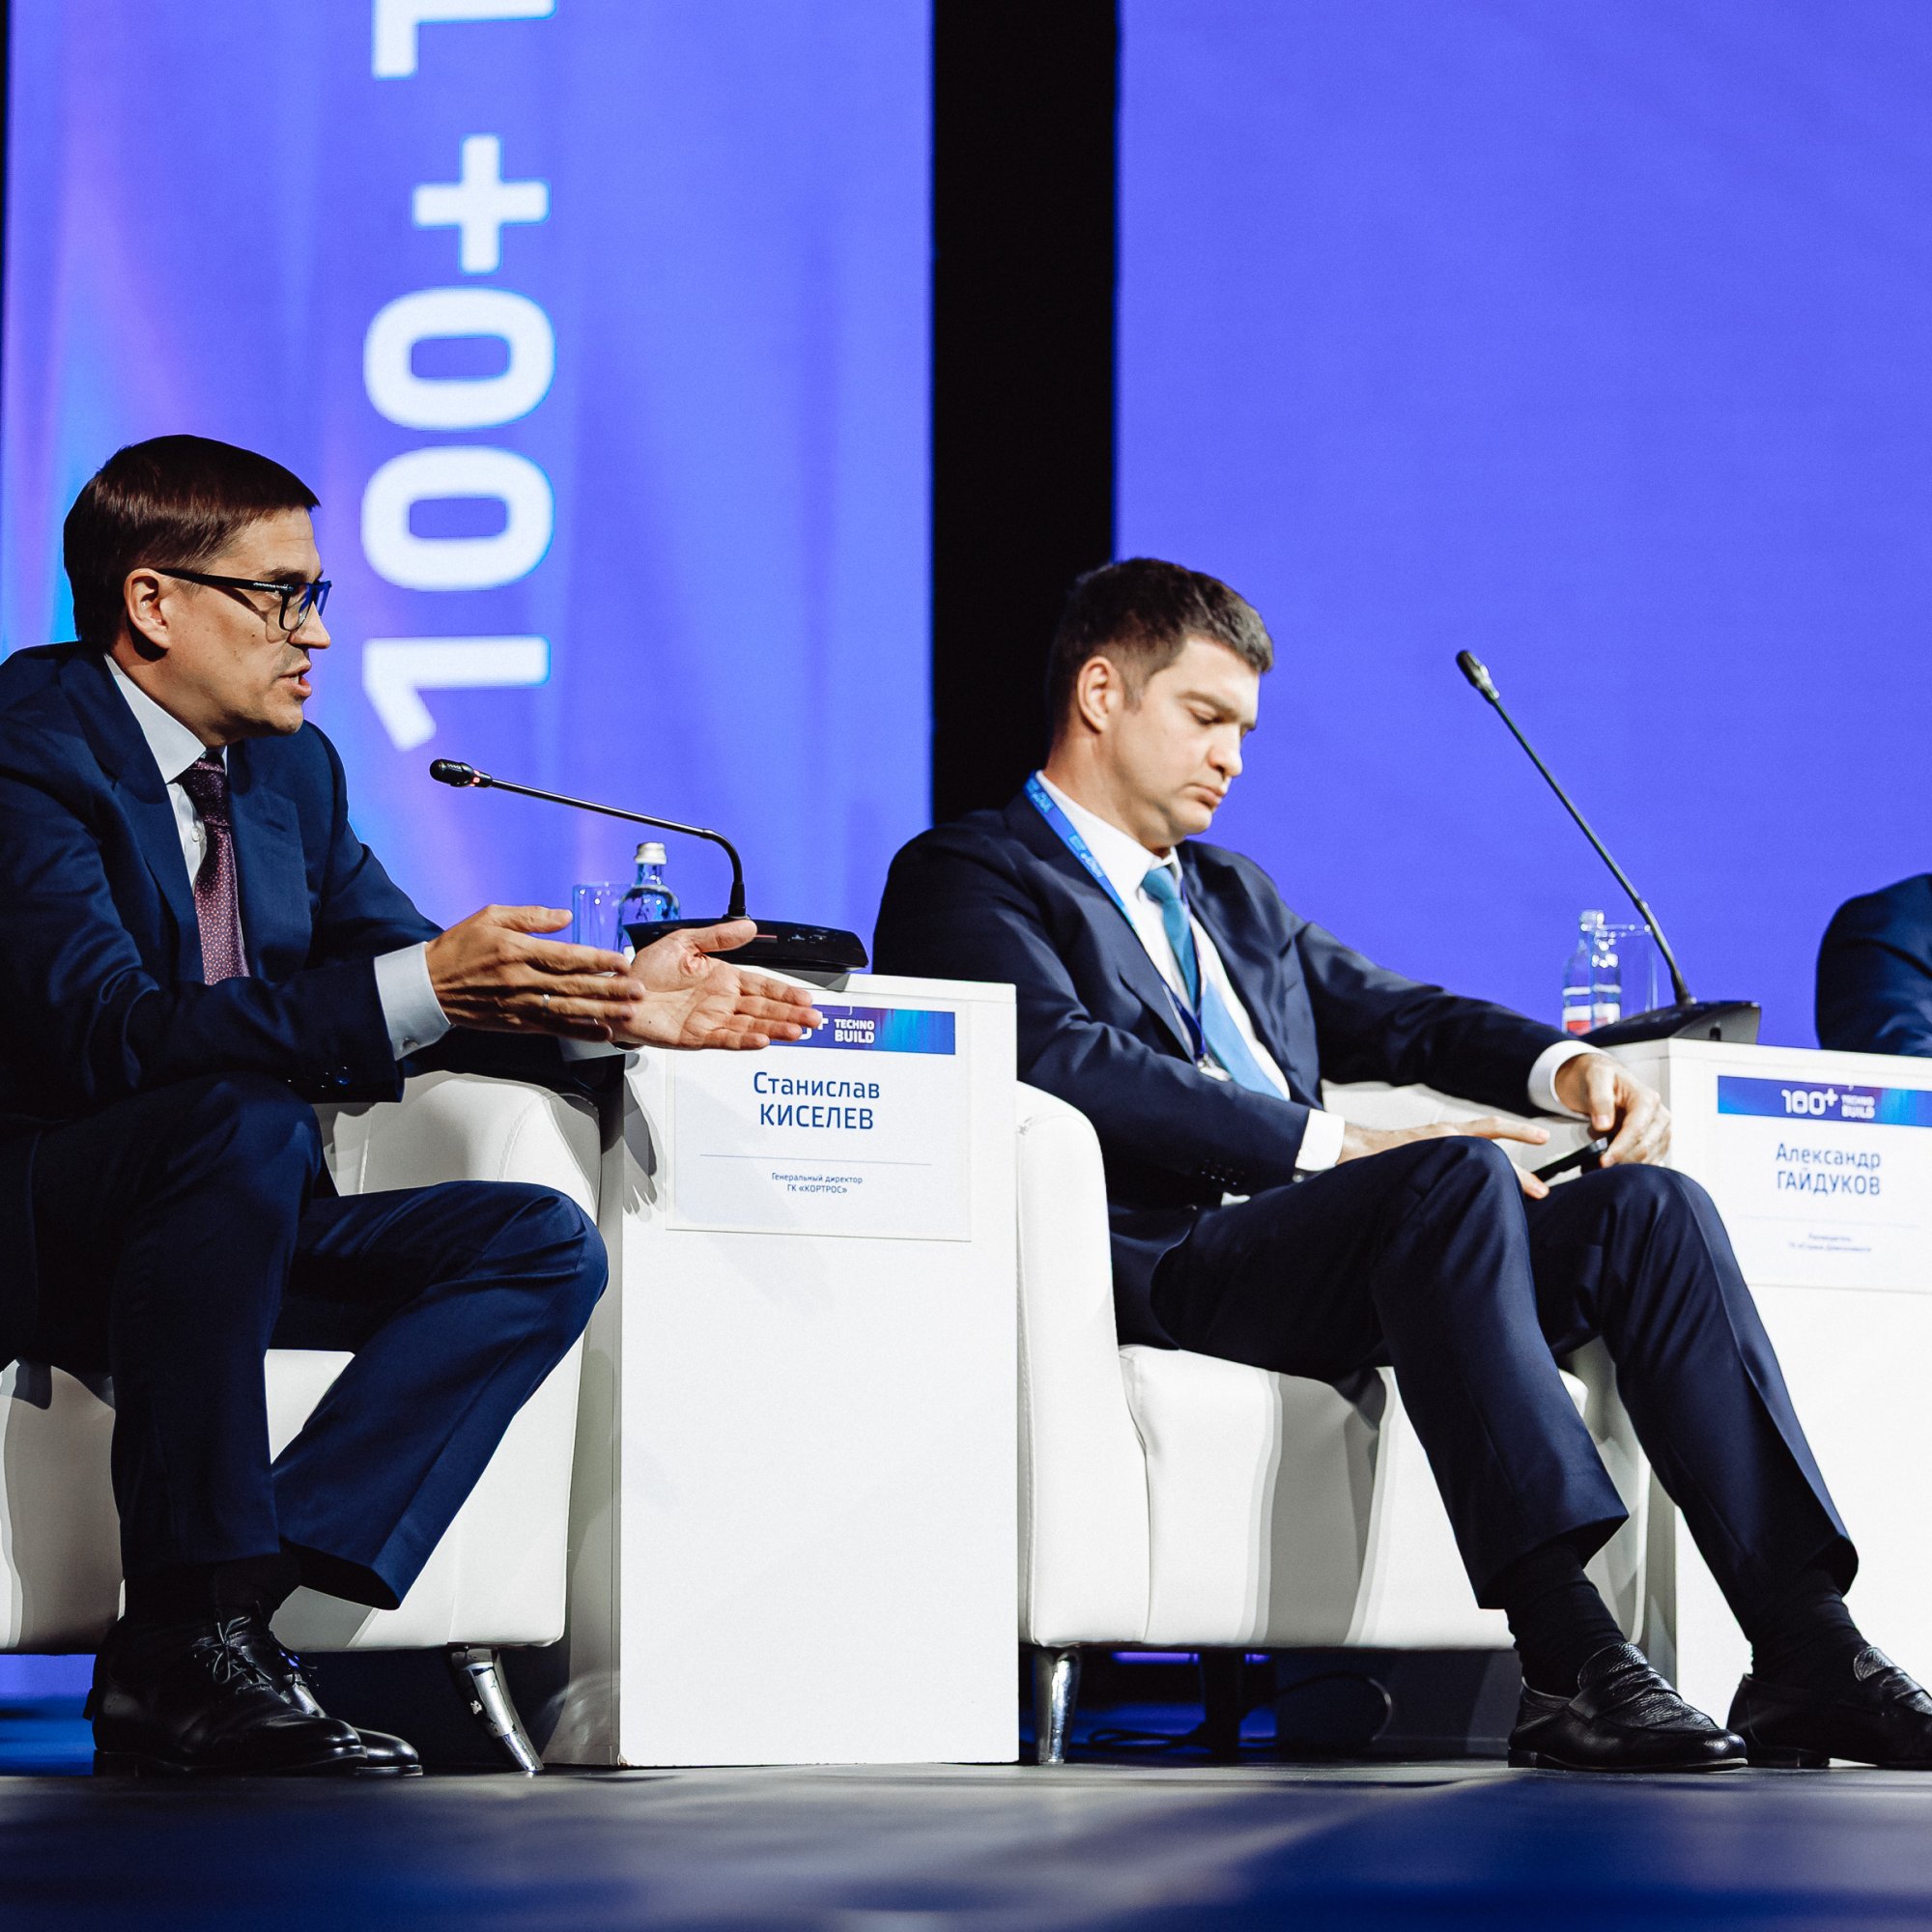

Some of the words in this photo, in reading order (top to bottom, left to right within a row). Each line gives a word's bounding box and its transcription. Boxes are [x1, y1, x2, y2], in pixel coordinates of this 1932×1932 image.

[361, 132, 557, 752] 100+
[834, 1018, 875, 1031] TECHNO
[834, 1030, 875, 1043] BUILD
[753, 1070, 880, 1099] Станислав
[1780, 1087, 1839, 1116] 100+
[760, 1103, 874, 1130] КИСЕЛЕВ
[1776, 1143, 1881, 1171] Александр
[771, 1172, 823, 1182] Генеральный
[825, 1176, 864, 1185] директор
[786, 1183, 797, 1192] ГК
[798, 1184, 848, 1194] «КОРТРОС»
[1777, 1167, 1881, 1196] ГАЙДУКОВ
